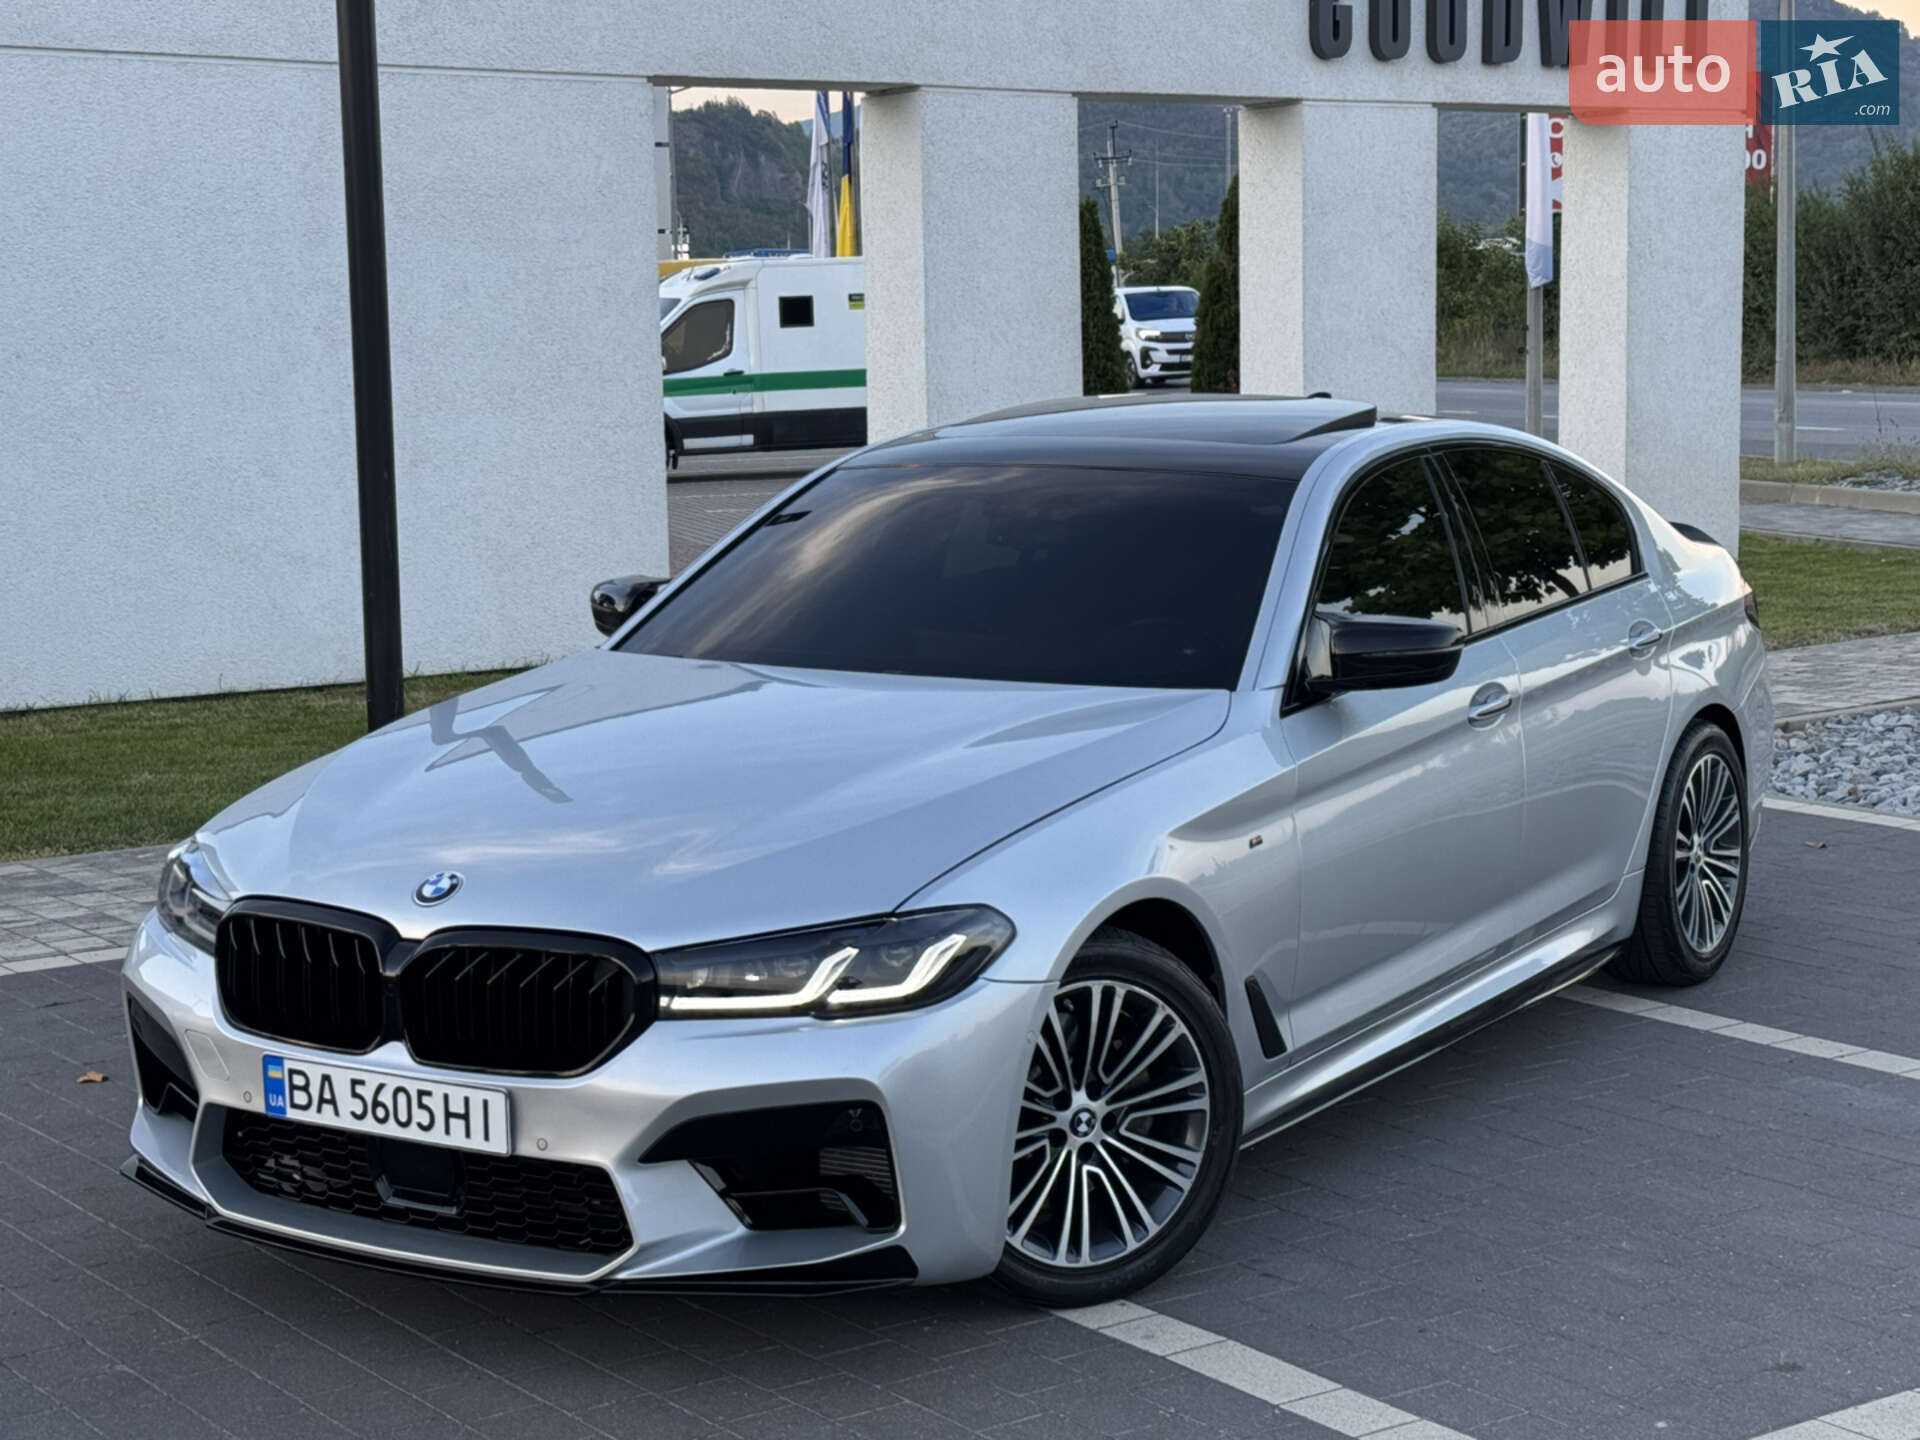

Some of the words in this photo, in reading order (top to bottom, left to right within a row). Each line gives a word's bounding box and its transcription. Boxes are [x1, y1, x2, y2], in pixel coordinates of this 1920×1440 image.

[269, 1093, 285, 1108] UA
[287, 1067, 340, 1117] BA
[349, 1077, 436, 1133] 5605
